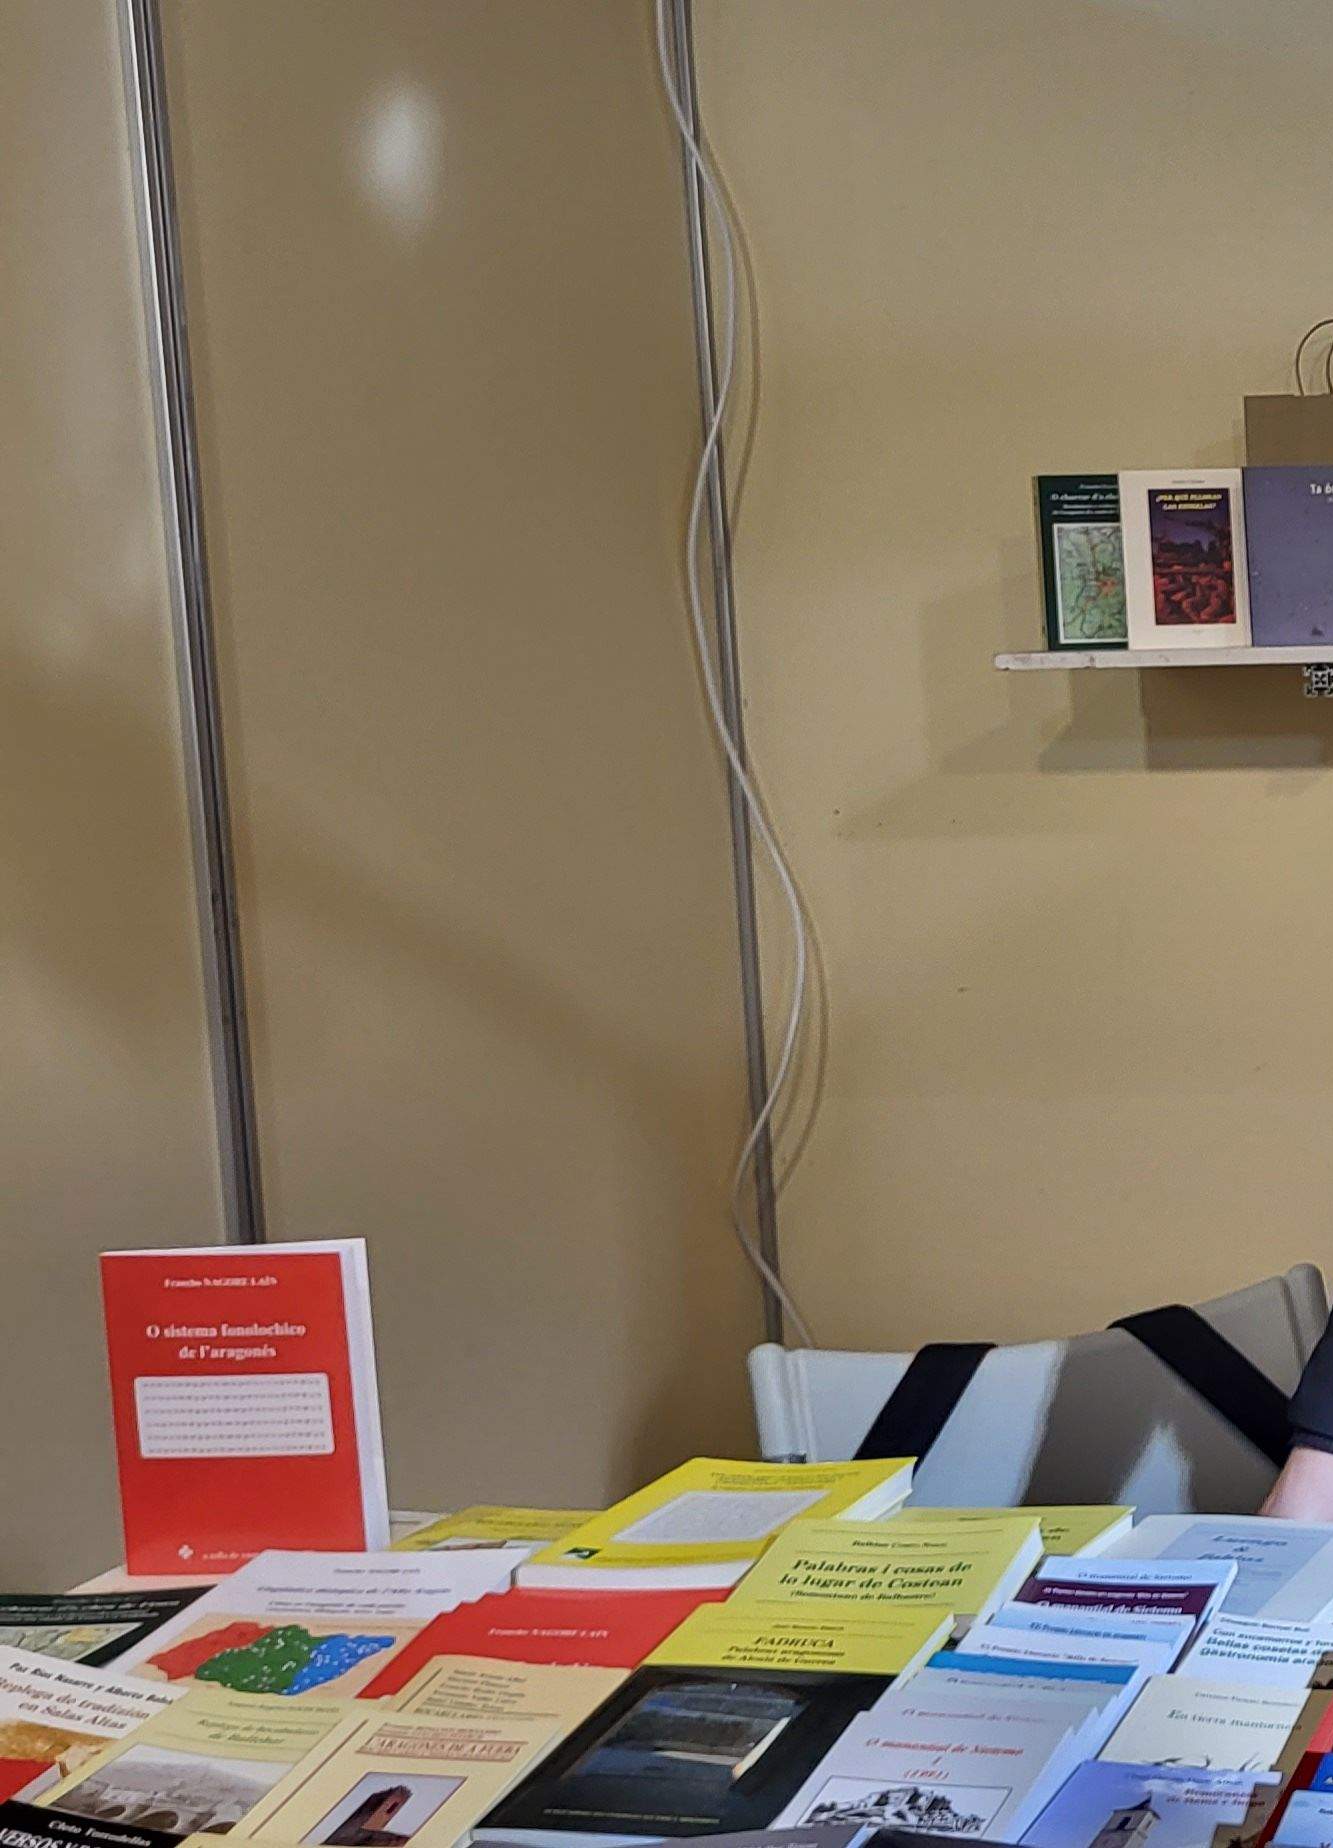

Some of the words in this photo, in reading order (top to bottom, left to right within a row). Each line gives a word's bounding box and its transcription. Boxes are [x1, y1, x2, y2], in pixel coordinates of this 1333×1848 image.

[146, 1325, 160, 1339] O
[163, 1323, 218, 1338] sistema
[179, 1345, 196, 1359] de
[199, 1344, 277, 1361] l'aragonés
[792, 1558, 880, 1574] Palabras
[893, 1565, 944, 1575] cosas
[949, 1561, 972, 1573] de
[778, 1573, 798, 1585] lo
[801, 1574, 857, 1589] lugar
[859, 1577, 883, 1589] de
[18, 1701, 39, 1712] en
[84, 1714, 127, 1730] Altas
